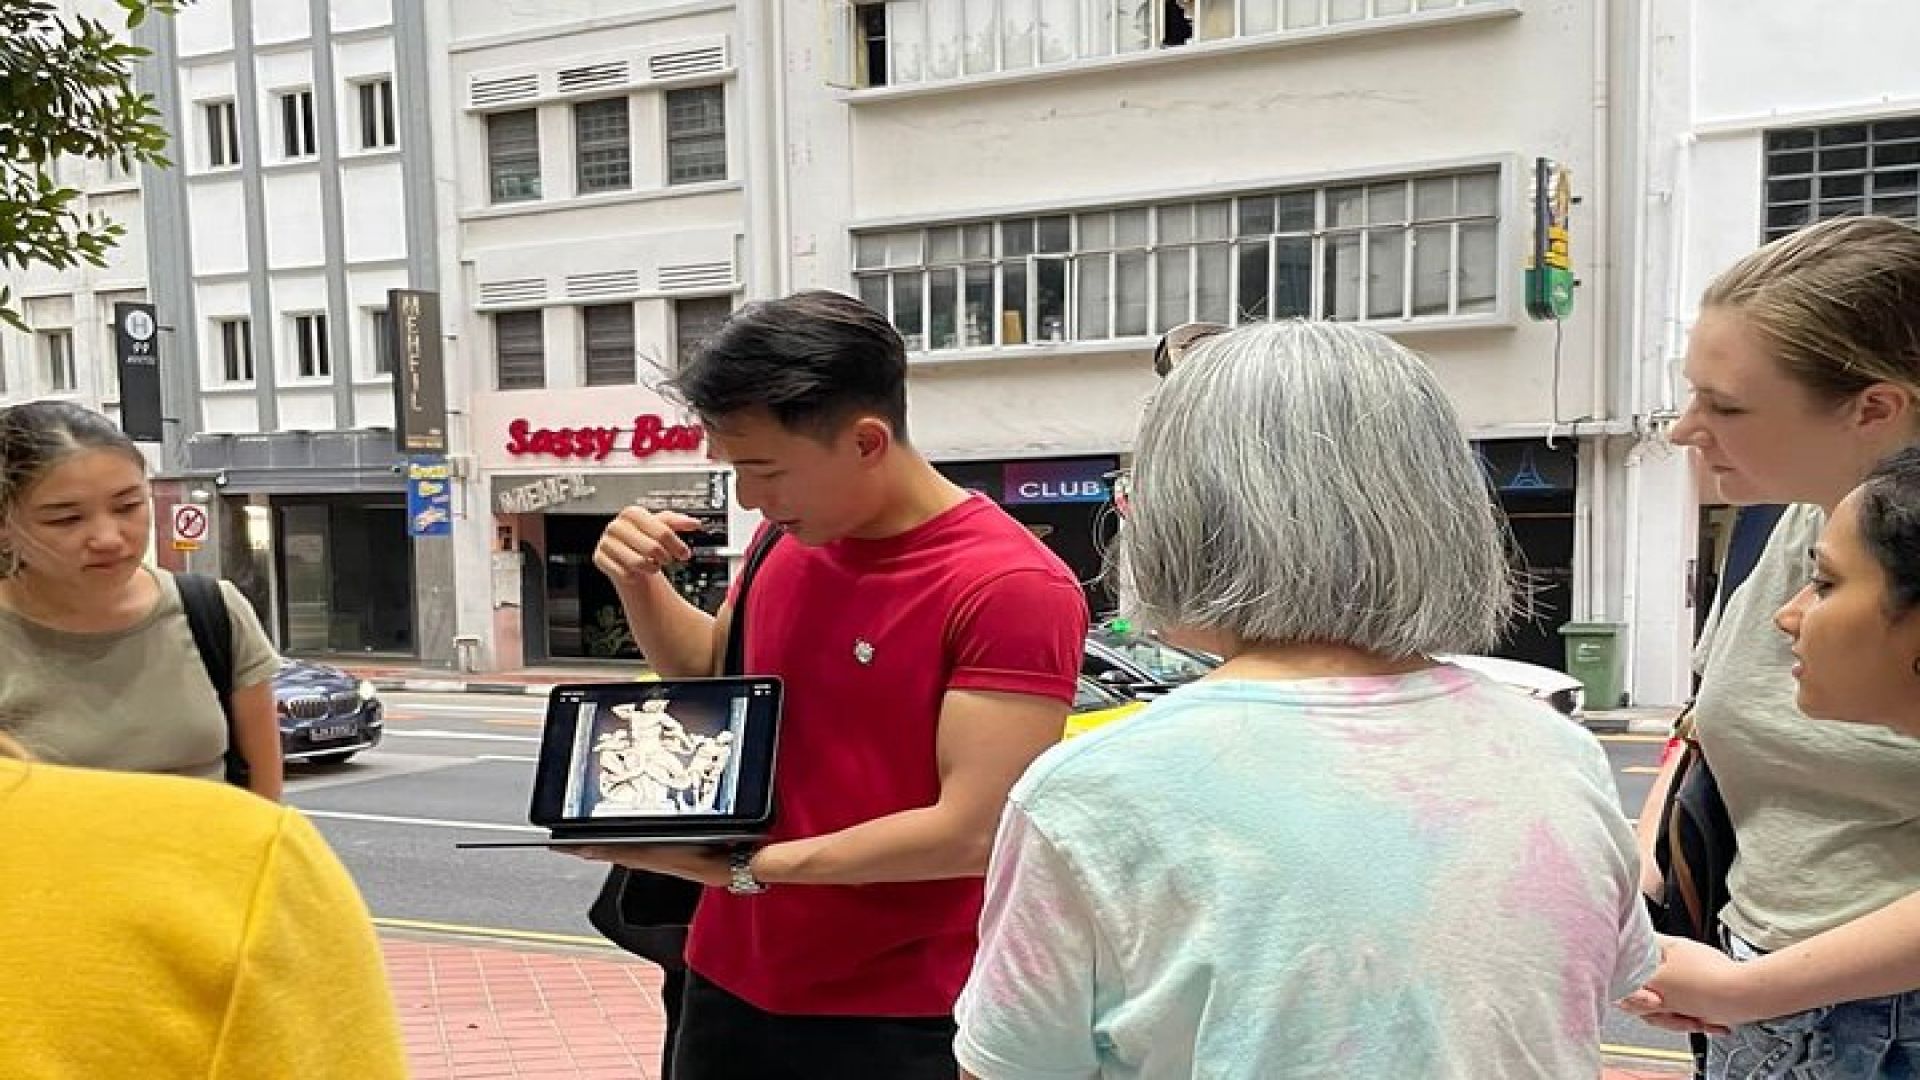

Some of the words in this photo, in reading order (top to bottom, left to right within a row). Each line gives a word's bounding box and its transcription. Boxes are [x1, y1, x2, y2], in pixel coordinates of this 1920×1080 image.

[402, 296, 422, 413] MEHFIL
[507, 418, 617, 461] Sassy
[632, 414, 704, 457] Bar
[1018, 480, 1100, 498] CLUB
